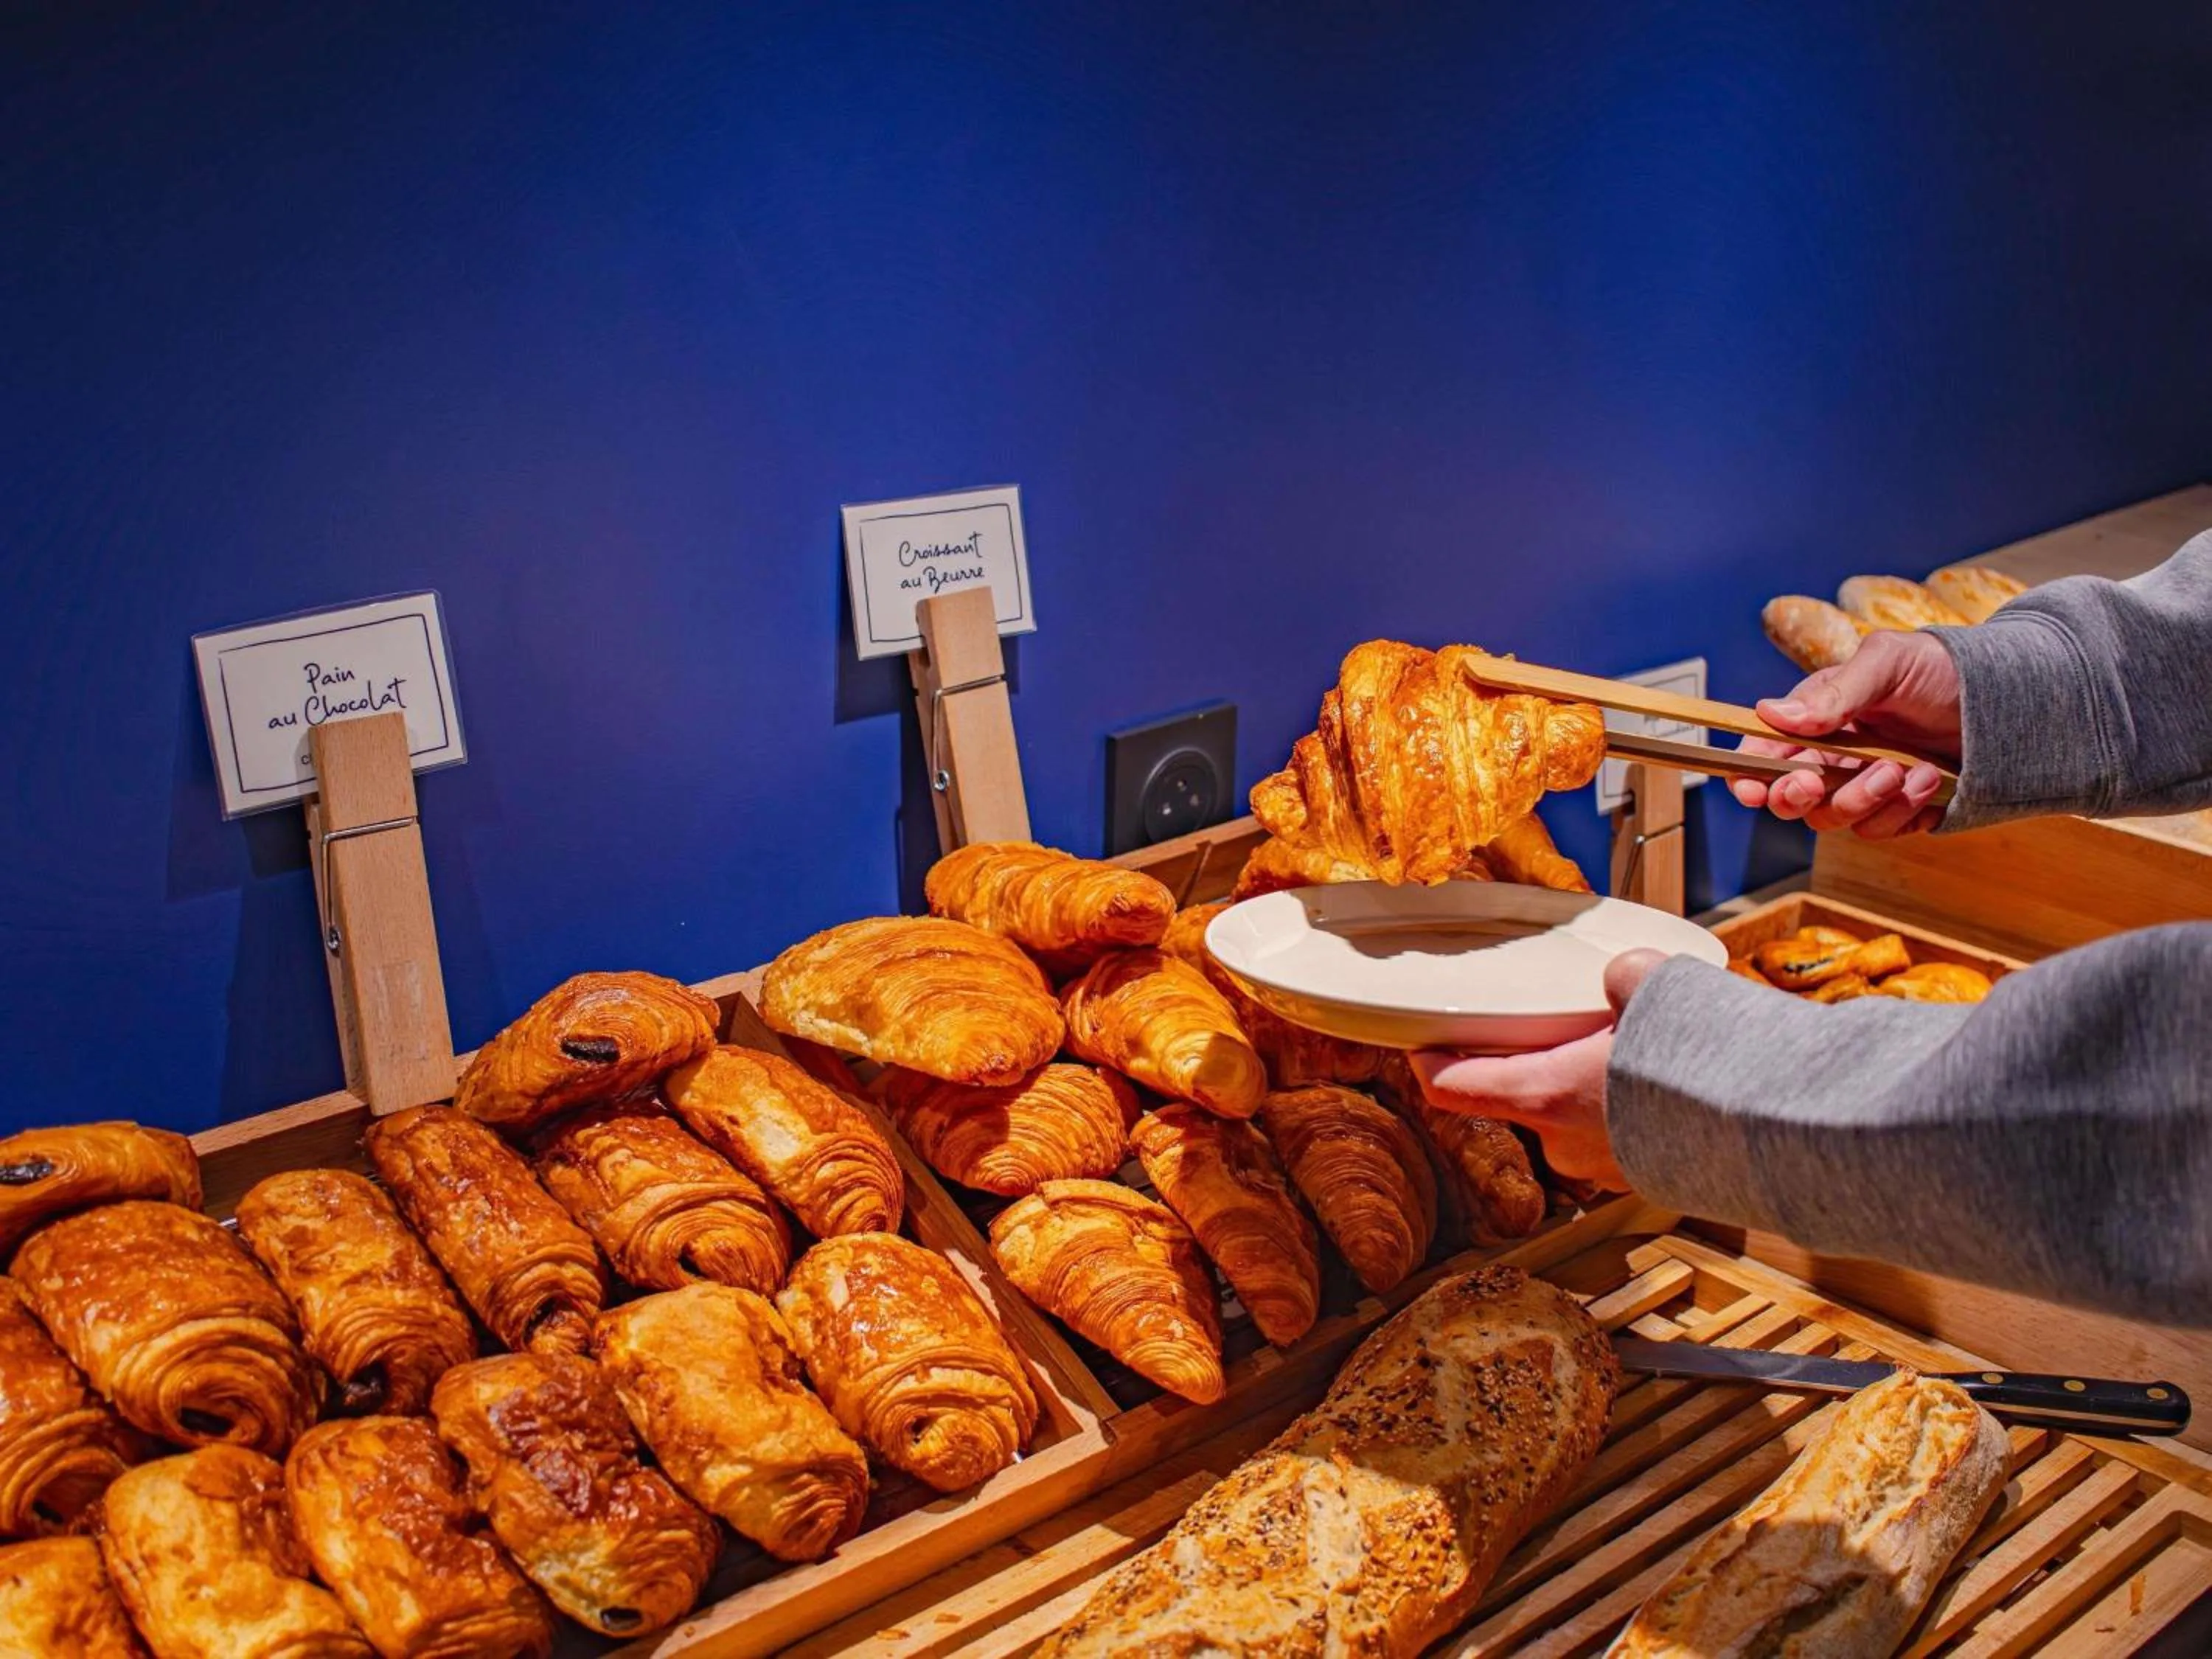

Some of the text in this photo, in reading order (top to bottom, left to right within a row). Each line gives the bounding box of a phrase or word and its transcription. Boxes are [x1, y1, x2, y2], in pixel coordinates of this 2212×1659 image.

[899, 532, 983, 567] Croissant
[900, 566, 984, 594] au Beurre
[304, 663, 355, 694] Pain
[268, 678, 407, 729] au Chocolat
